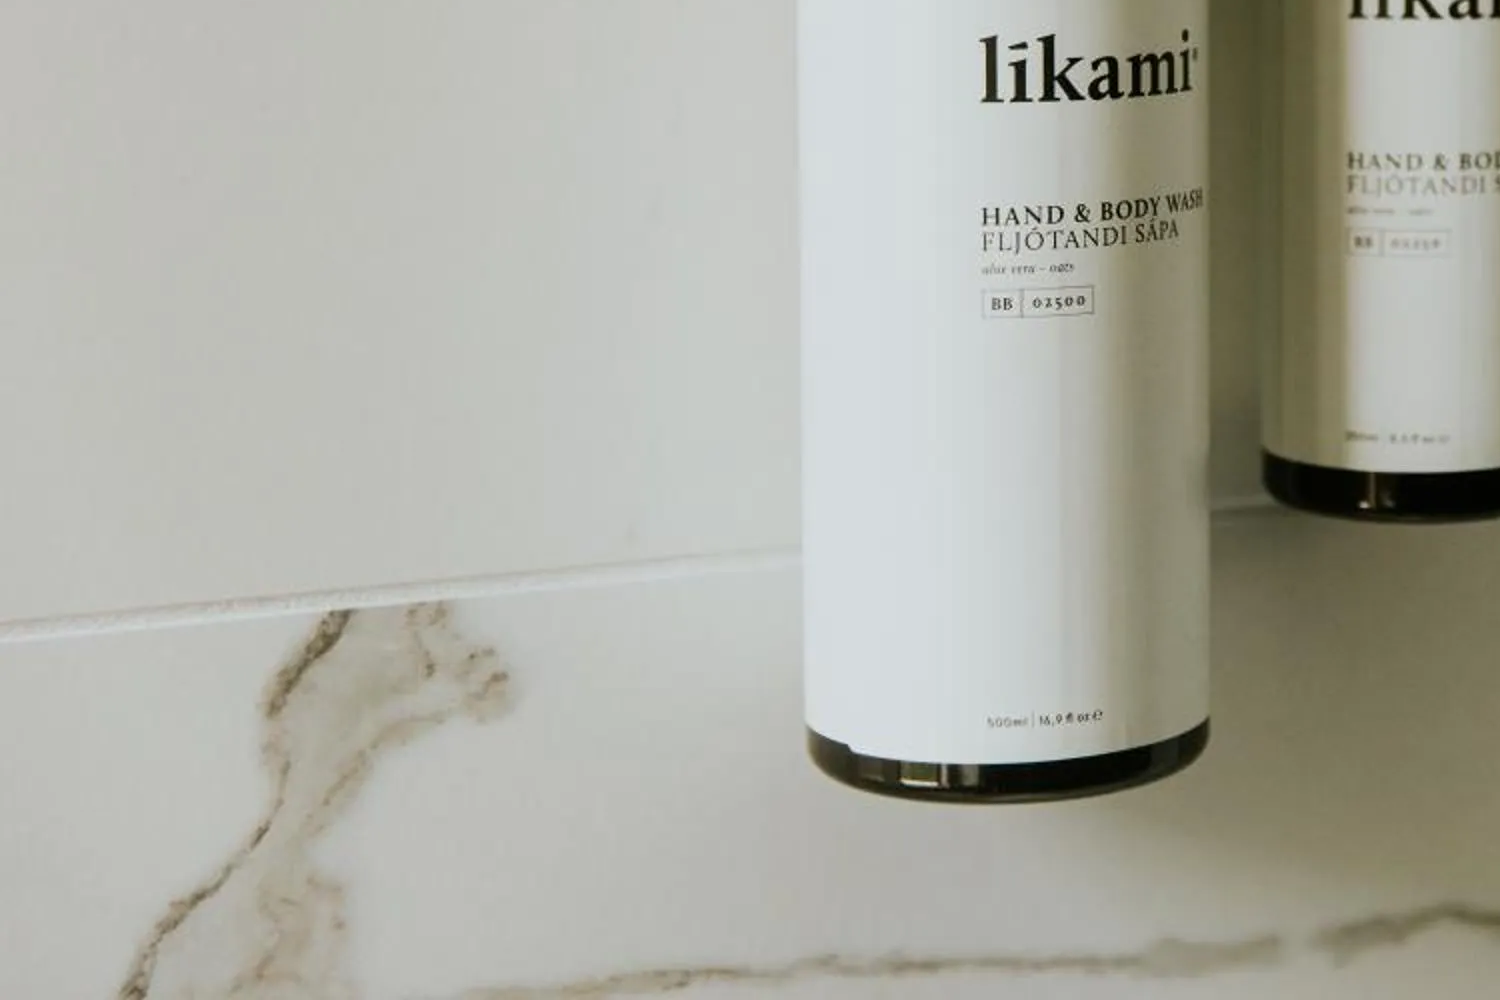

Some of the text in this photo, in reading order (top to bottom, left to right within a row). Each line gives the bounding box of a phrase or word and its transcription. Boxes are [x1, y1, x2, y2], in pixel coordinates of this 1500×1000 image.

[1347, 151, 1423, 171] HAND
[1433, 153, 1448, 170] &
[981, 187, 1203, 227] HAND & BODY WASH
[981, 218, 1179, 255] FLJÓTANDI SÁPA
[991, 295, 1087, 311] BB 02500
